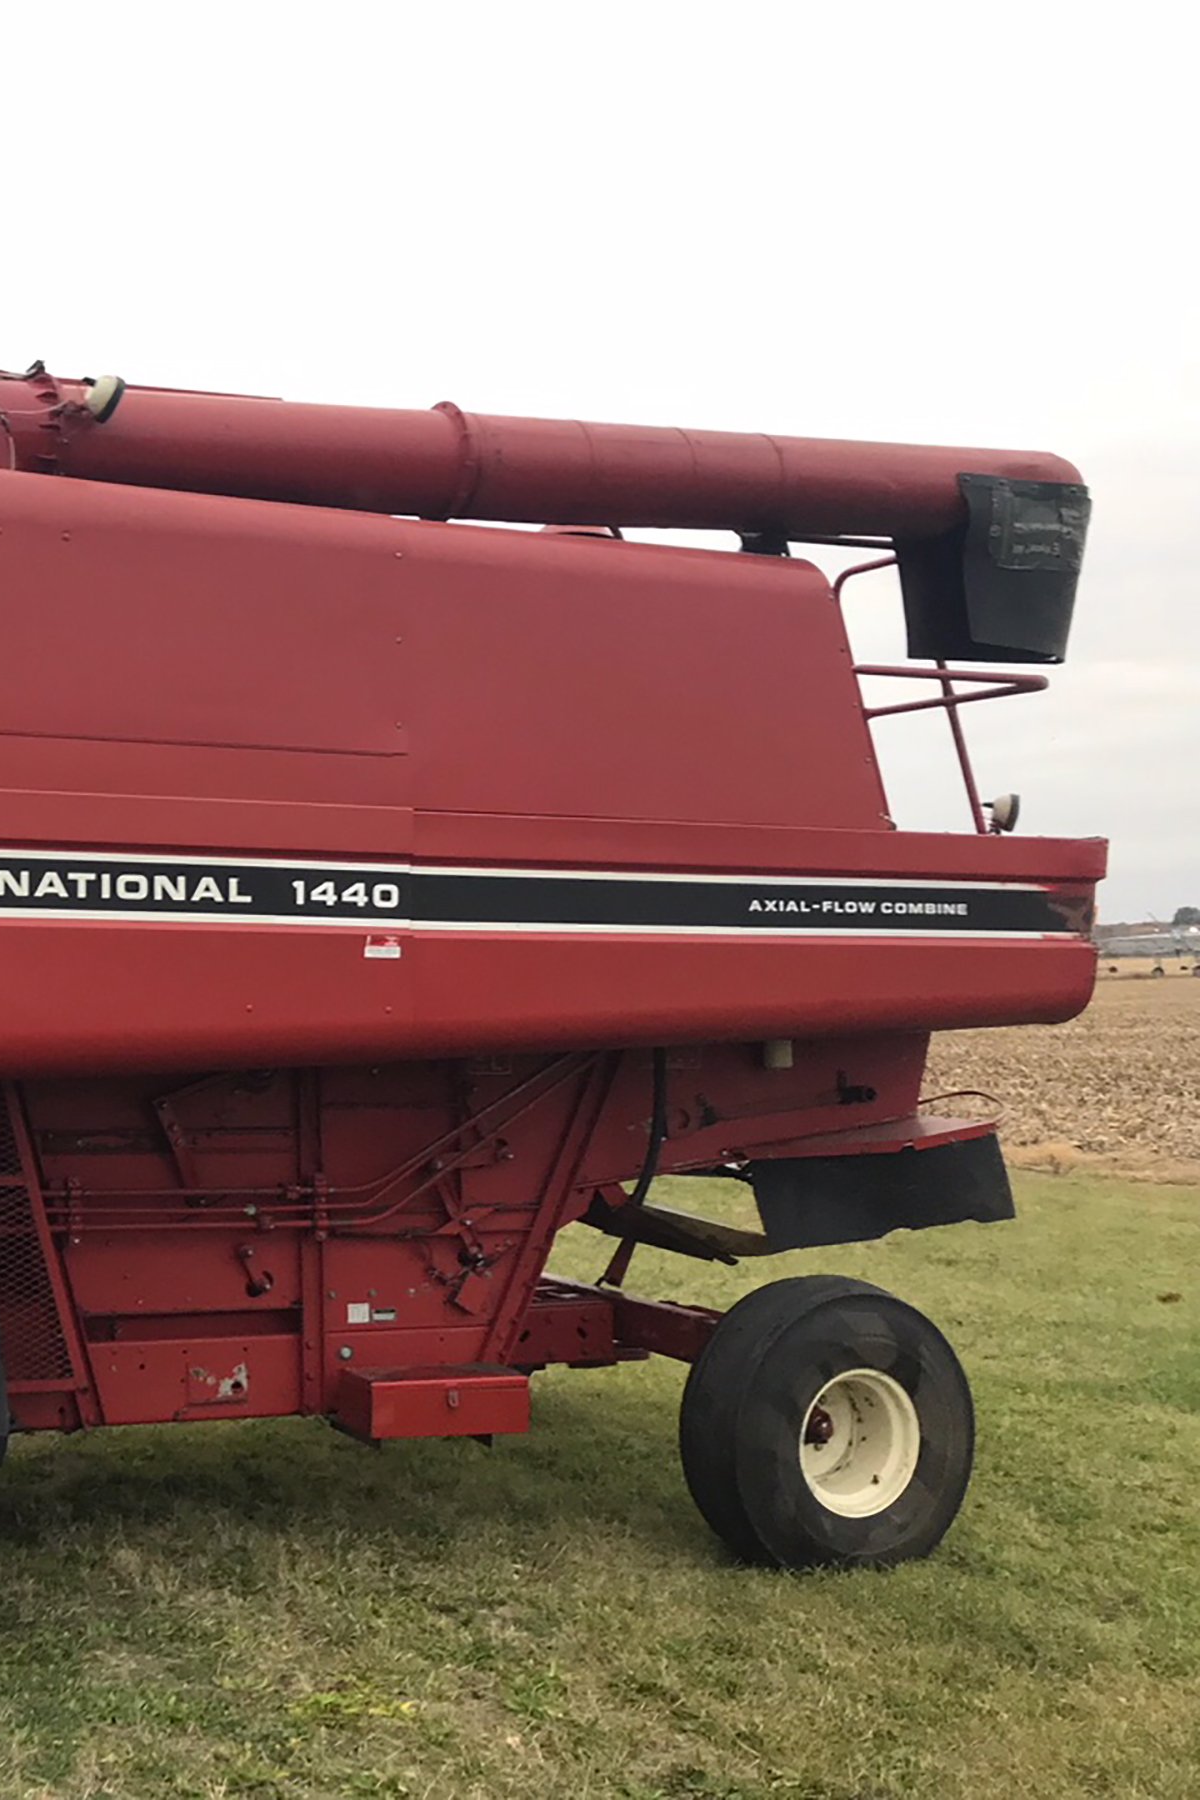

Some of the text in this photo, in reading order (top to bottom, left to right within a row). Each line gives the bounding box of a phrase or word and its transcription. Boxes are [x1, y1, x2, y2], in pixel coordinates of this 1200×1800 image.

[292, 880, 400, 909] 1440
[748, 899, 968, 916] AXIAL-FLOW COMBINE
